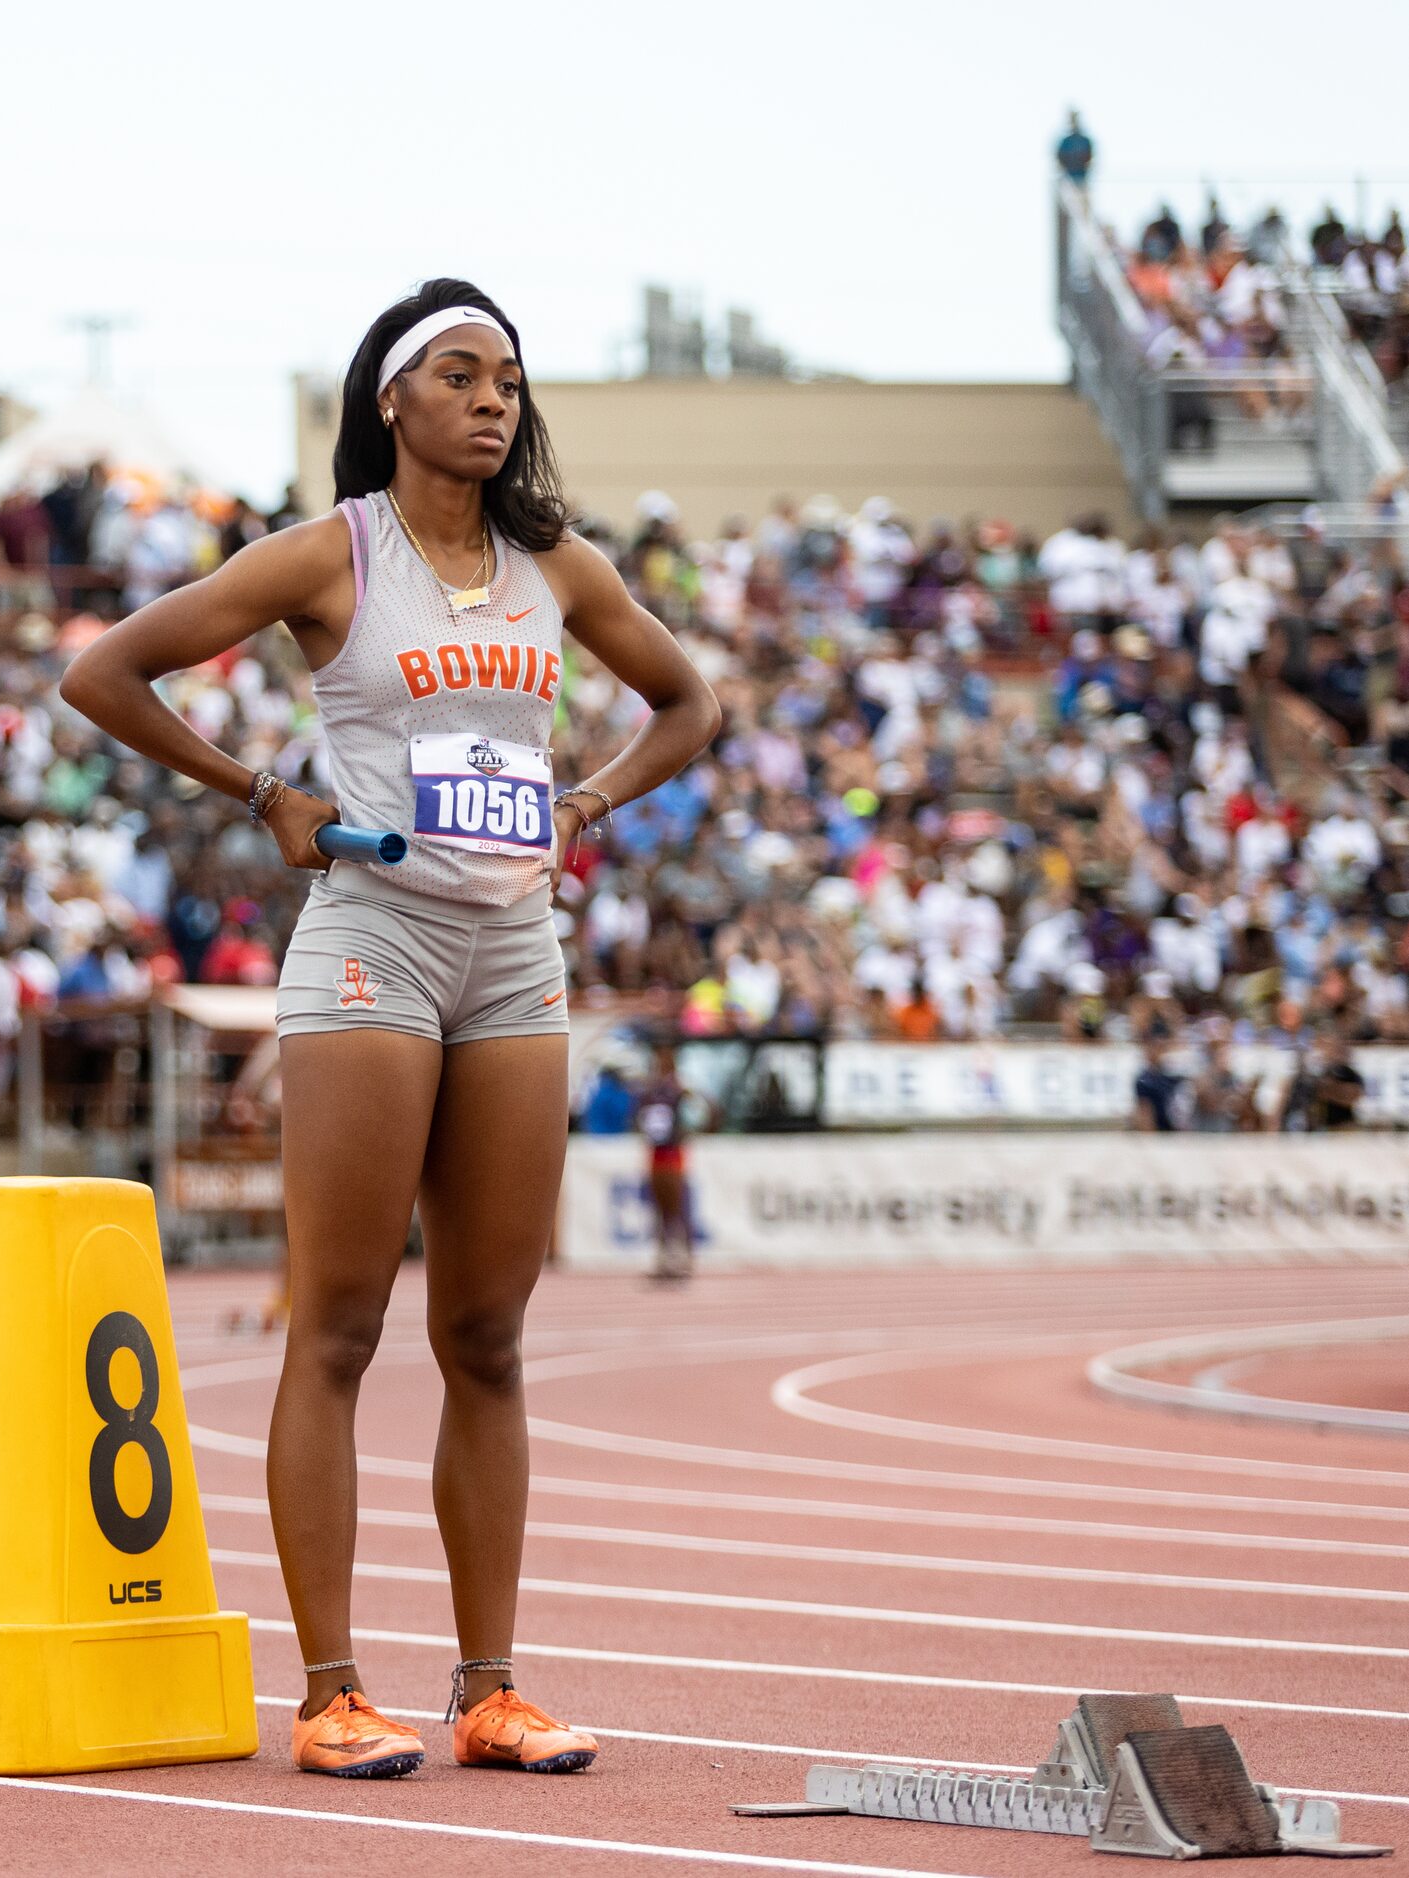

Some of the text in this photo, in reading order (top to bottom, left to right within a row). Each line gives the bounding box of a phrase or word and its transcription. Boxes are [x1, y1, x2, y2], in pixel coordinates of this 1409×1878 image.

[395, 642, 561, 704] BOWIE
[432, 779, 541, 840] 1056
[478, 841, 501, 852] 2022
[85, 1311, 173, 1555] 8
[108, 1580, 162, 1604] UCS
